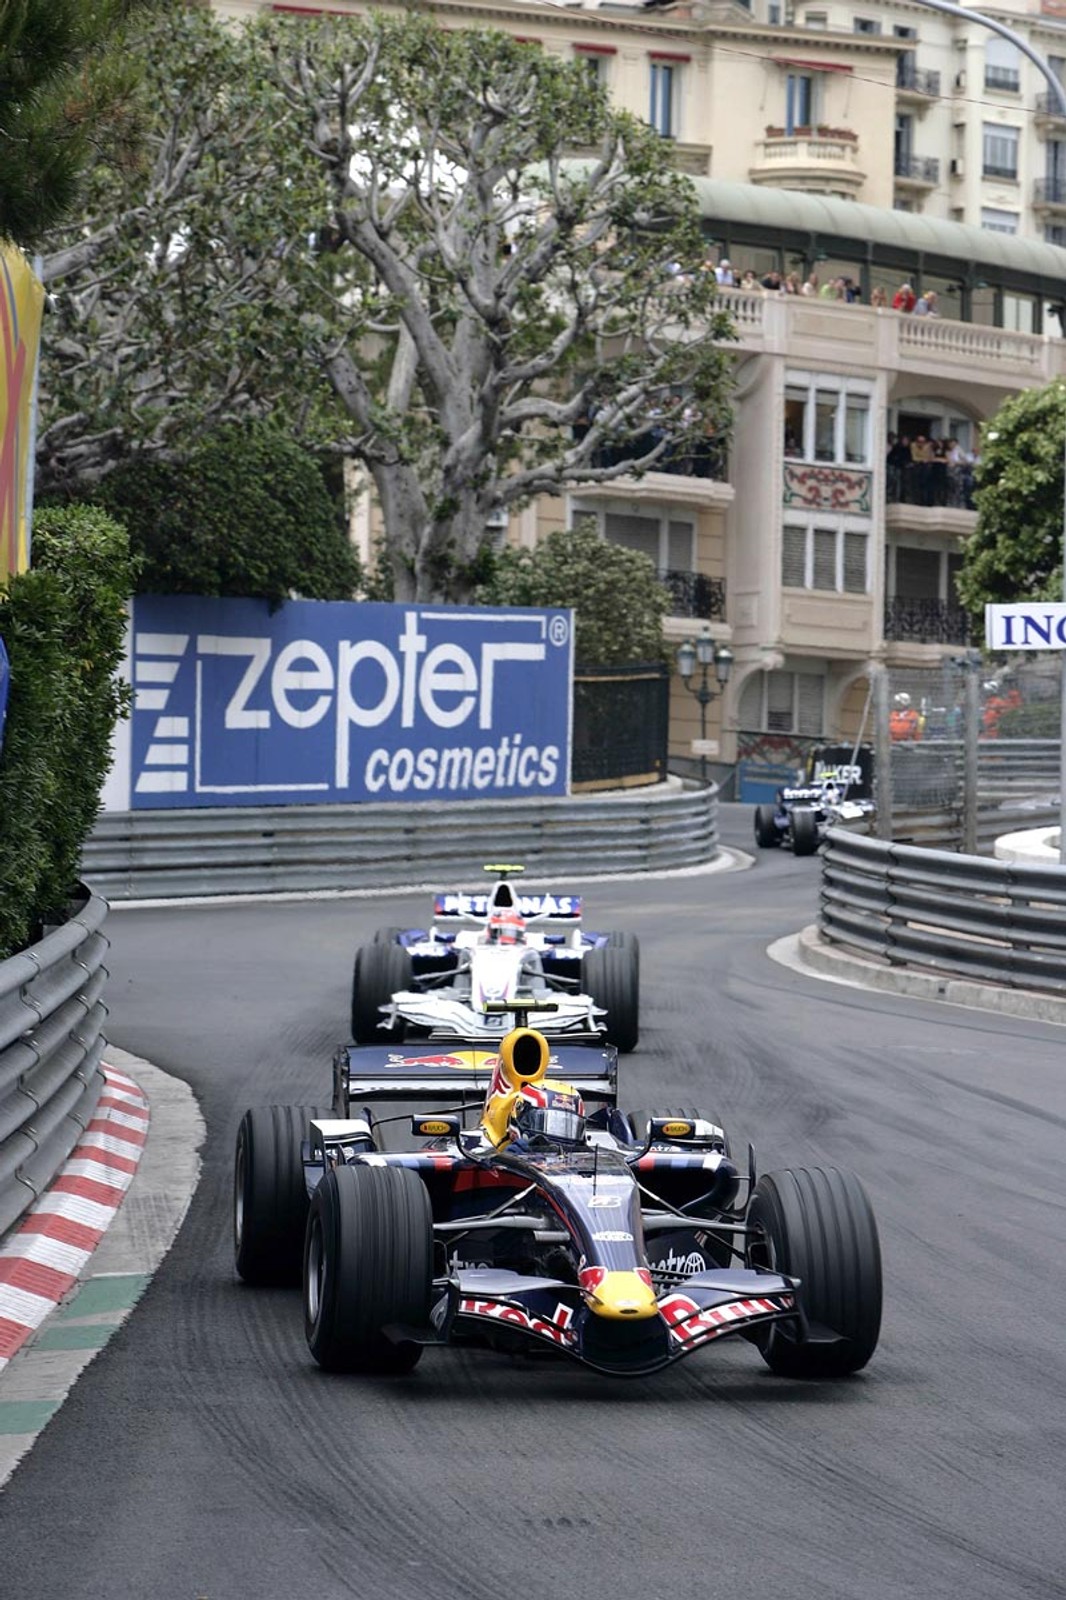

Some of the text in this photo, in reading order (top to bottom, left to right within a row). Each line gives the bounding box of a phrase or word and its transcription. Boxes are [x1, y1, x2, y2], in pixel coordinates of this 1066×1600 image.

[197, 612, 546, 789] zepter
[364, 733, 559, 792] cosmetics
[443, 895, 572, 914] PETNAS
